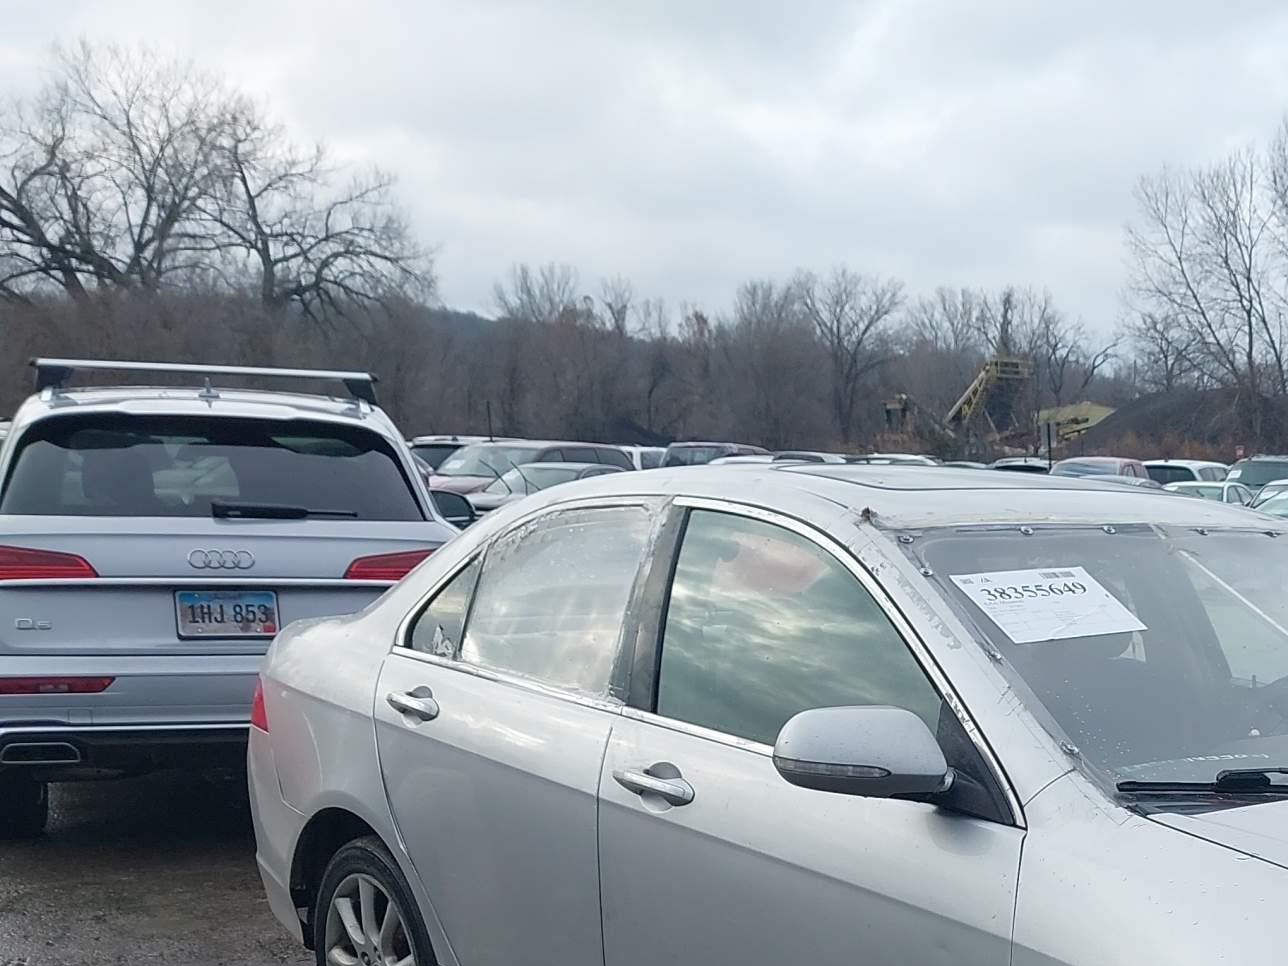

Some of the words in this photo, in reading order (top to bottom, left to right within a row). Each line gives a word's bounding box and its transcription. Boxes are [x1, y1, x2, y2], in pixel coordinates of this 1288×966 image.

[980, 581, 1088, 602] 38355649
[188, 604, 225, 624] 1HJ
[233, 604, 269, 624] 853
